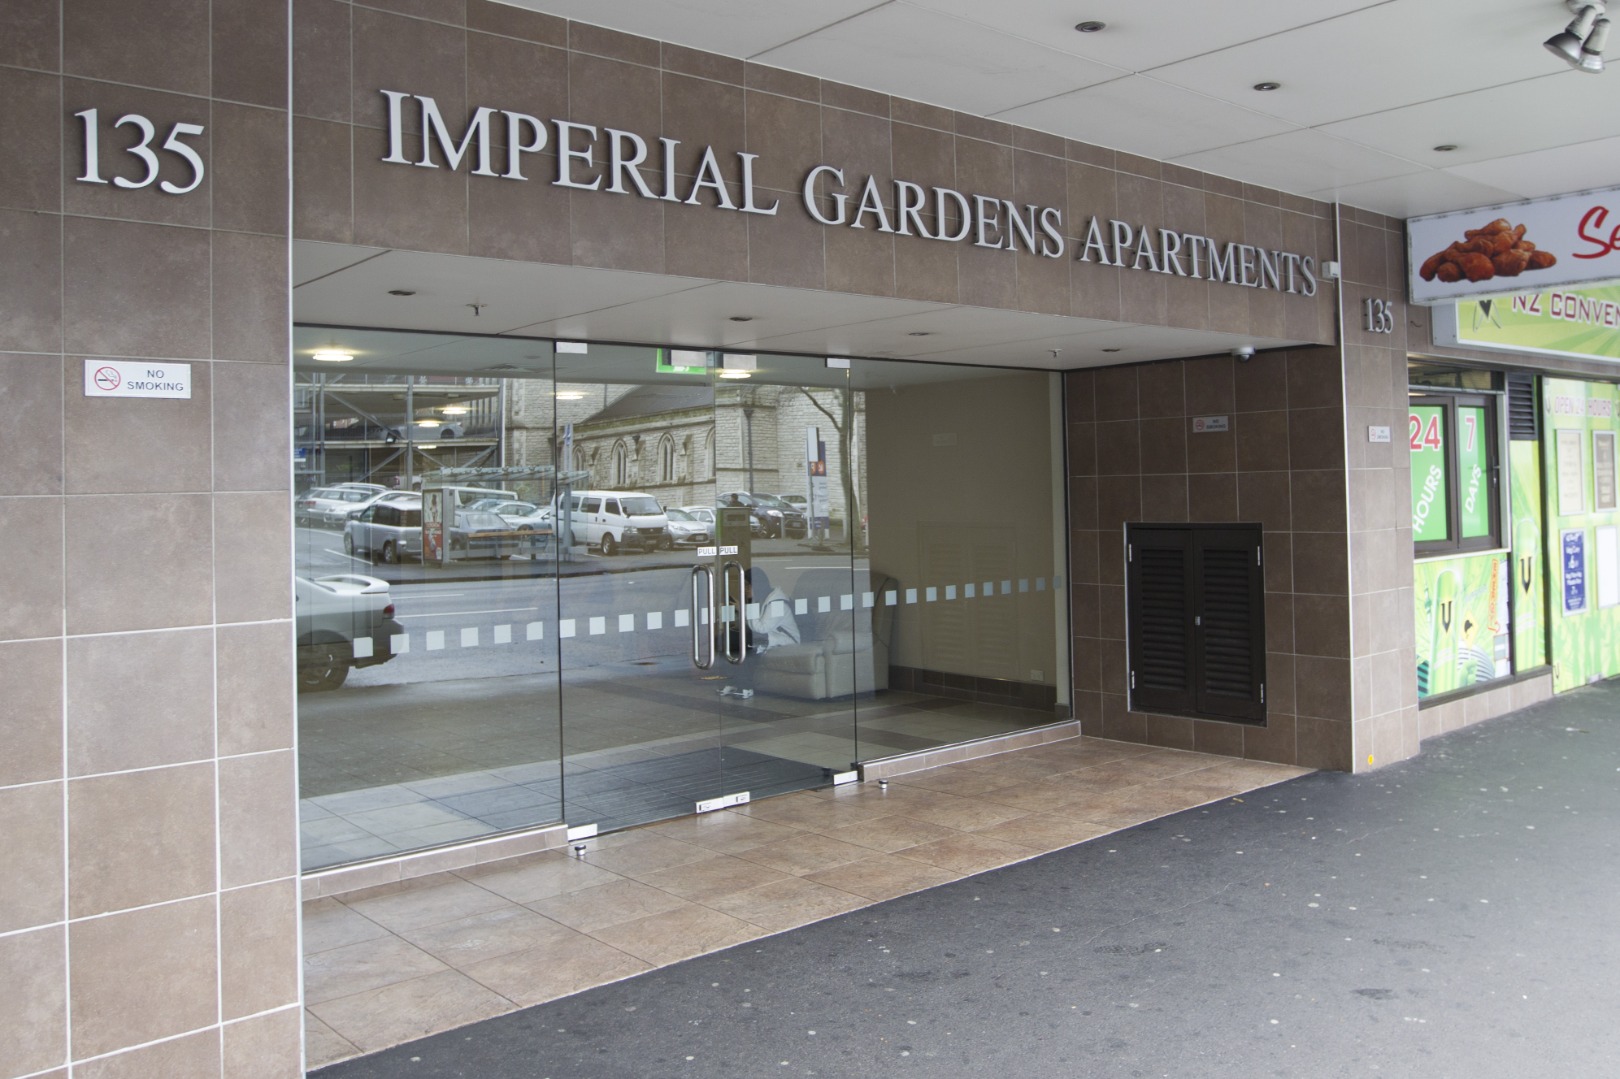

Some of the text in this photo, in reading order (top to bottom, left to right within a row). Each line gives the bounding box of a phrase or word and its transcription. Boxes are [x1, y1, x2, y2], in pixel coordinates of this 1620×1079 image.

[74, 108, 205, 194] 135
[380, 89, 1317, 297] IMPERIAL GARDENS APARTMENTS
[1366, 298, 1394, 334] 135
[1513, 293, 1541, 313] NZ
[127, 381, 184, 391] SMOKING
[147, 369, 165, 379] NO
[1588, 398, 1611, 417] HOURS
[1409, 415, 1441, 450] 24
[1465, 416, 1476, 450] 7
[1412, 464, 1442, 534] HOURS
[1465, 463, 1482, 514] DAYS
[698, 547, 716, 555] PULL
